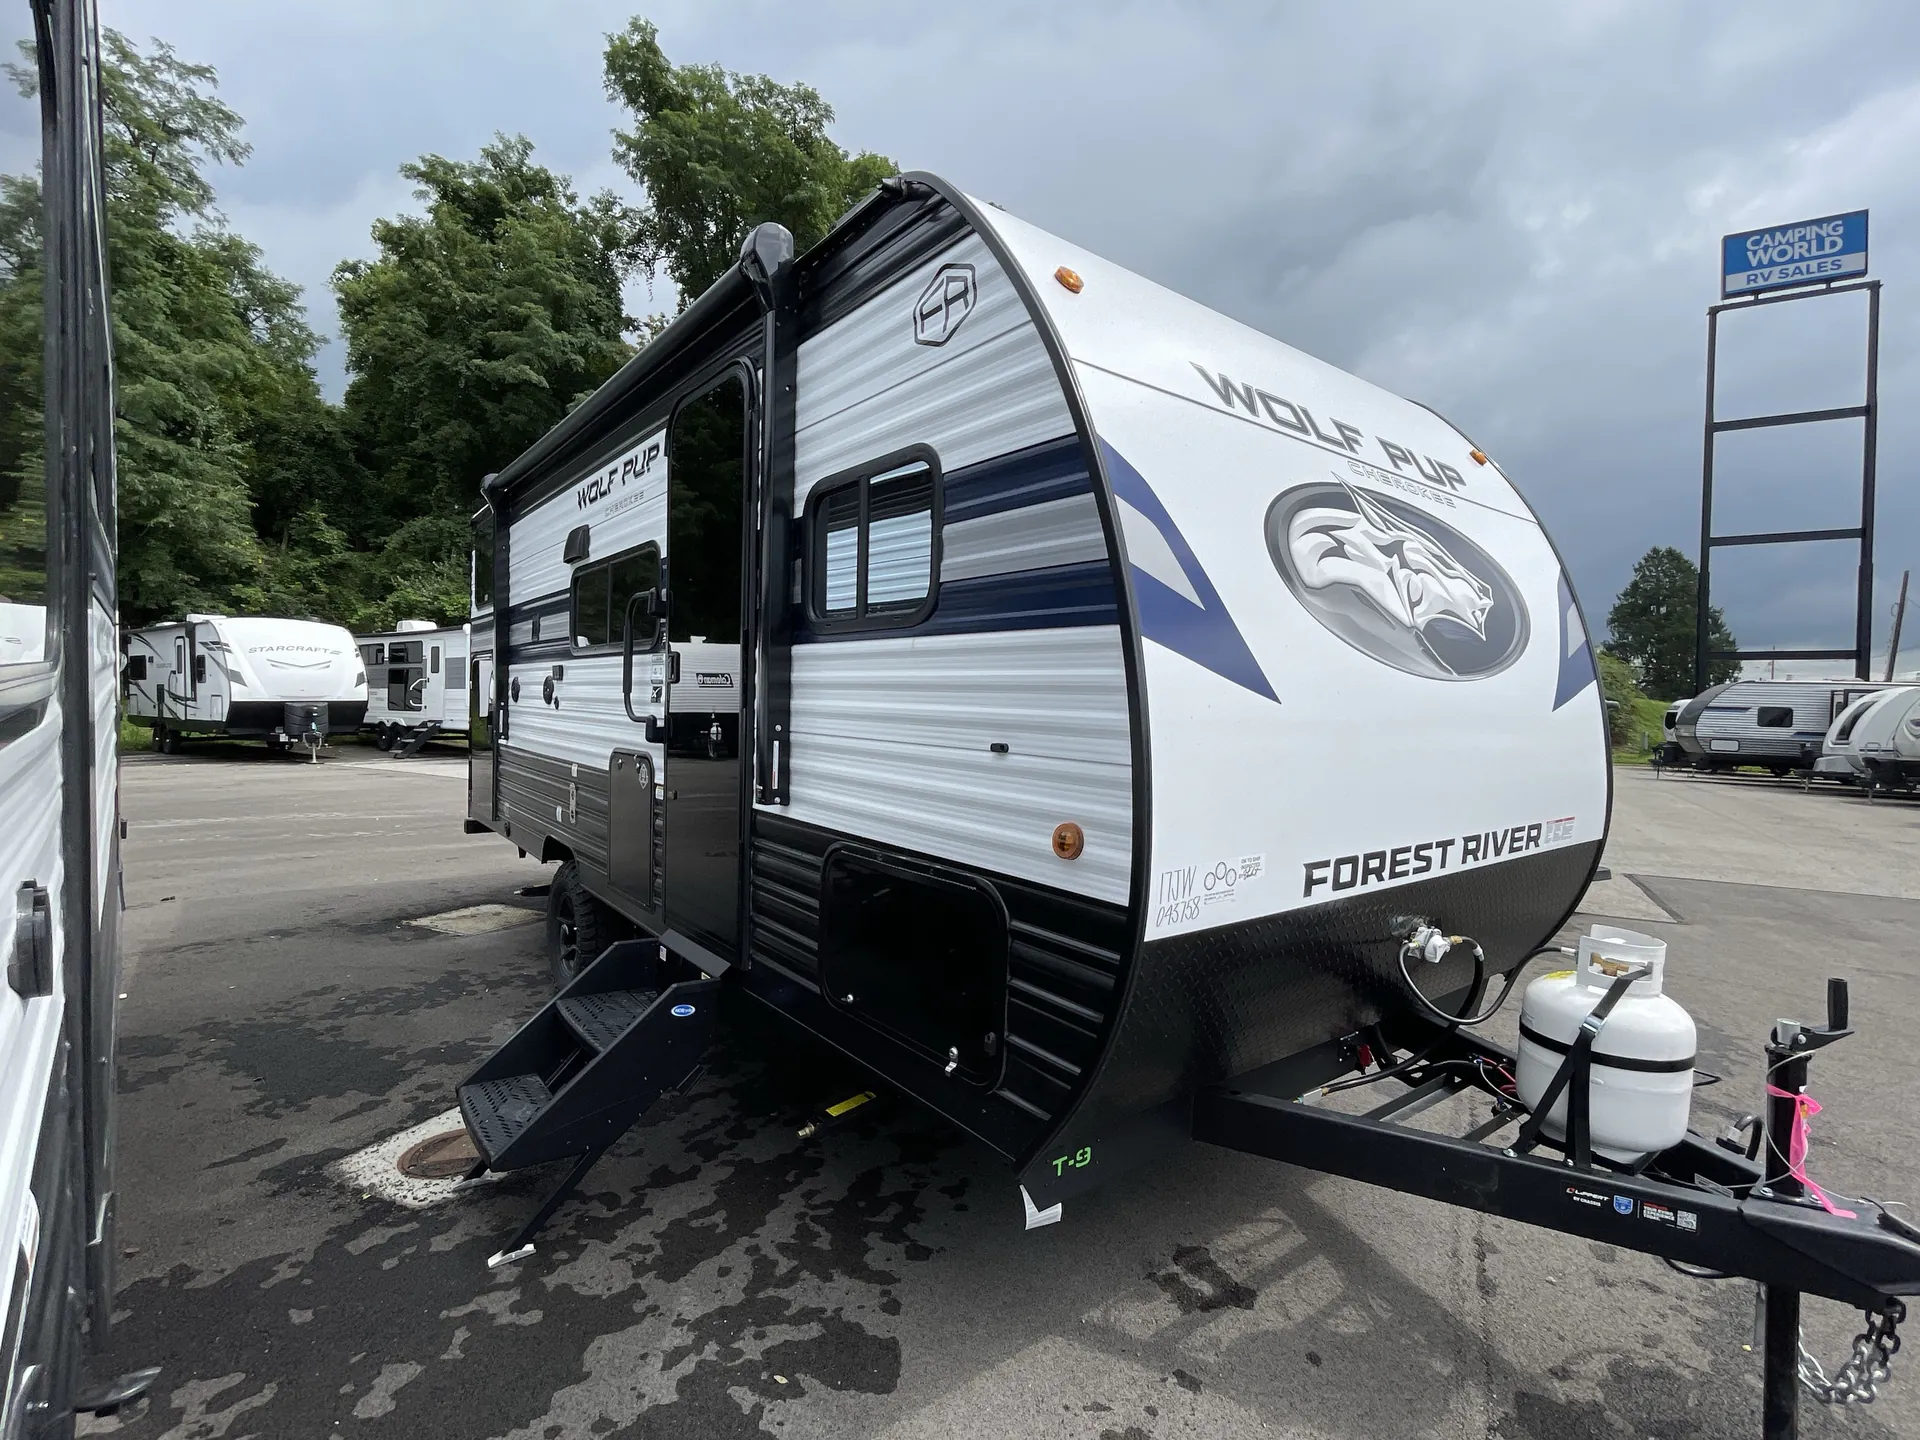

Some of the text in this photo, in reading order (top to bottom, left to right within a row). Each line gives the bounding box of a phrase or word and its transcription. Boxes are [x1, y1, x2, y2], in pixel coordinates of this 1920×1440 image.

[1746, 220, 1844, 250] CAMPING
[1746, 236, 1844, 267] WORLD
[1746, 258, 1842, 286] RV SALES
[1188, 360, 1467, 492] WOLF PUP
[577, 442, 660, 511] WOLF PUP
[1346, 460, 1457, 509] CHEROKEE
[248, 645, 330, 654] STARCRAFT
[1302, 838, 1456, 899] FOREST
[1461, 823, 1543, 865] RIVER
[1052, 1146, 1092, 1177] T-9
